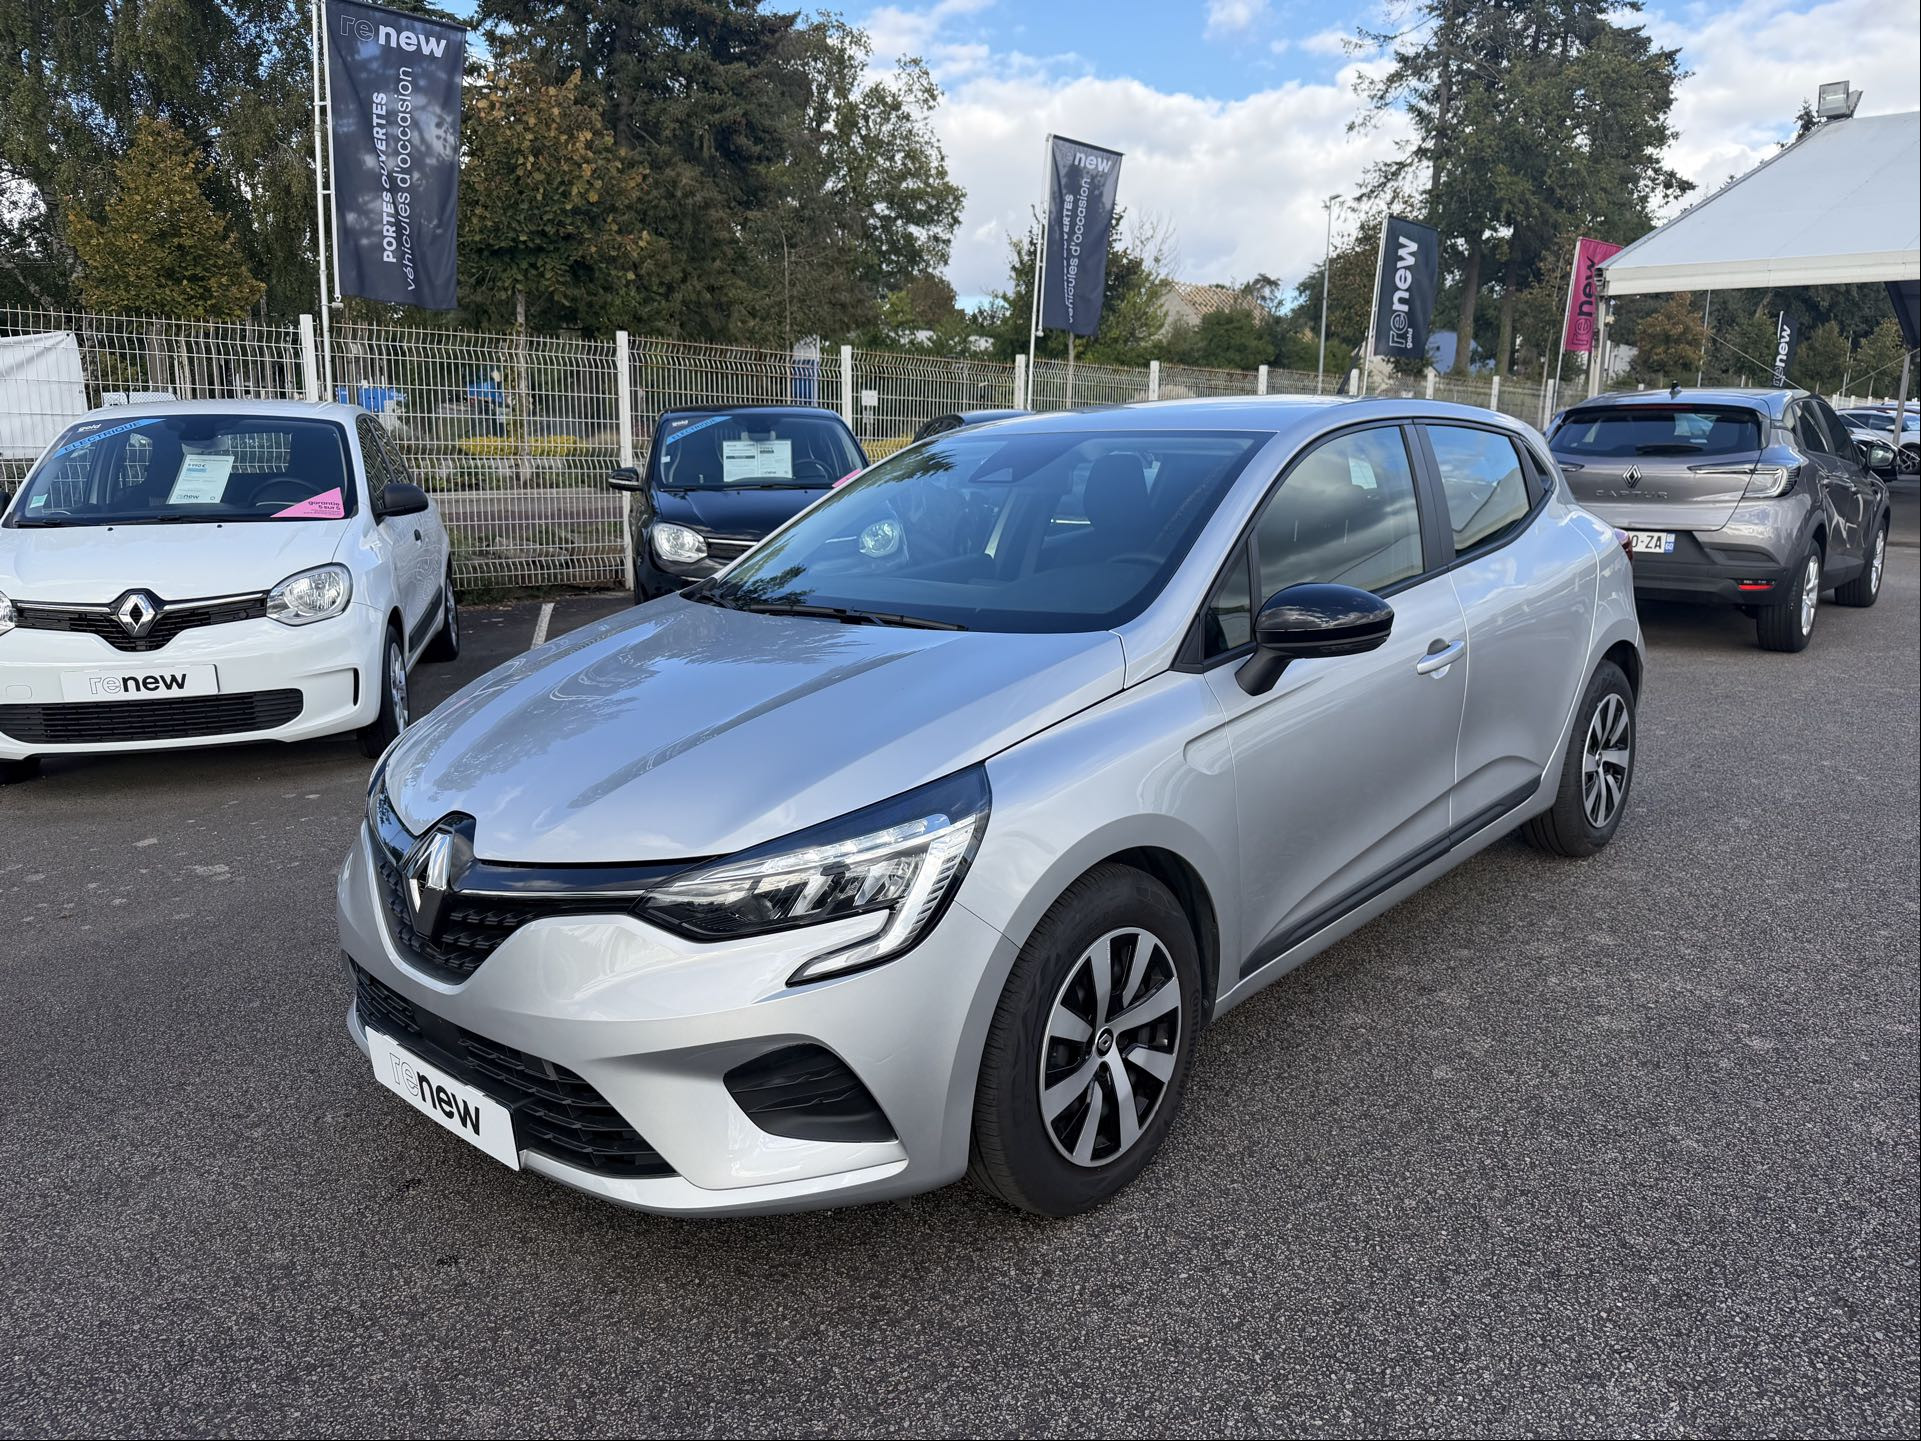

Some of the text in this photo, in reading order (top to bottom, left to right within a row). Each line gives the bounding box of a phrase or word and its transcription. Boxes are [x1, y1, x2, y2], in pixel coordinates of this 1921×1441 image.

[340, 14, 447, 58] renew
[372, 91, 397, 264] PORTES OUVERTES
[393, 66, 416, 291] véhicules d'occasion
[1069, 178, 1090, 256] d'occasion
[1390, 236, 1418, 348] renew
[1595, 489, 1668, 499] CAPTUR
[88, 673, 187, 695] renew
[389, 1052, 480, 1137] renew
